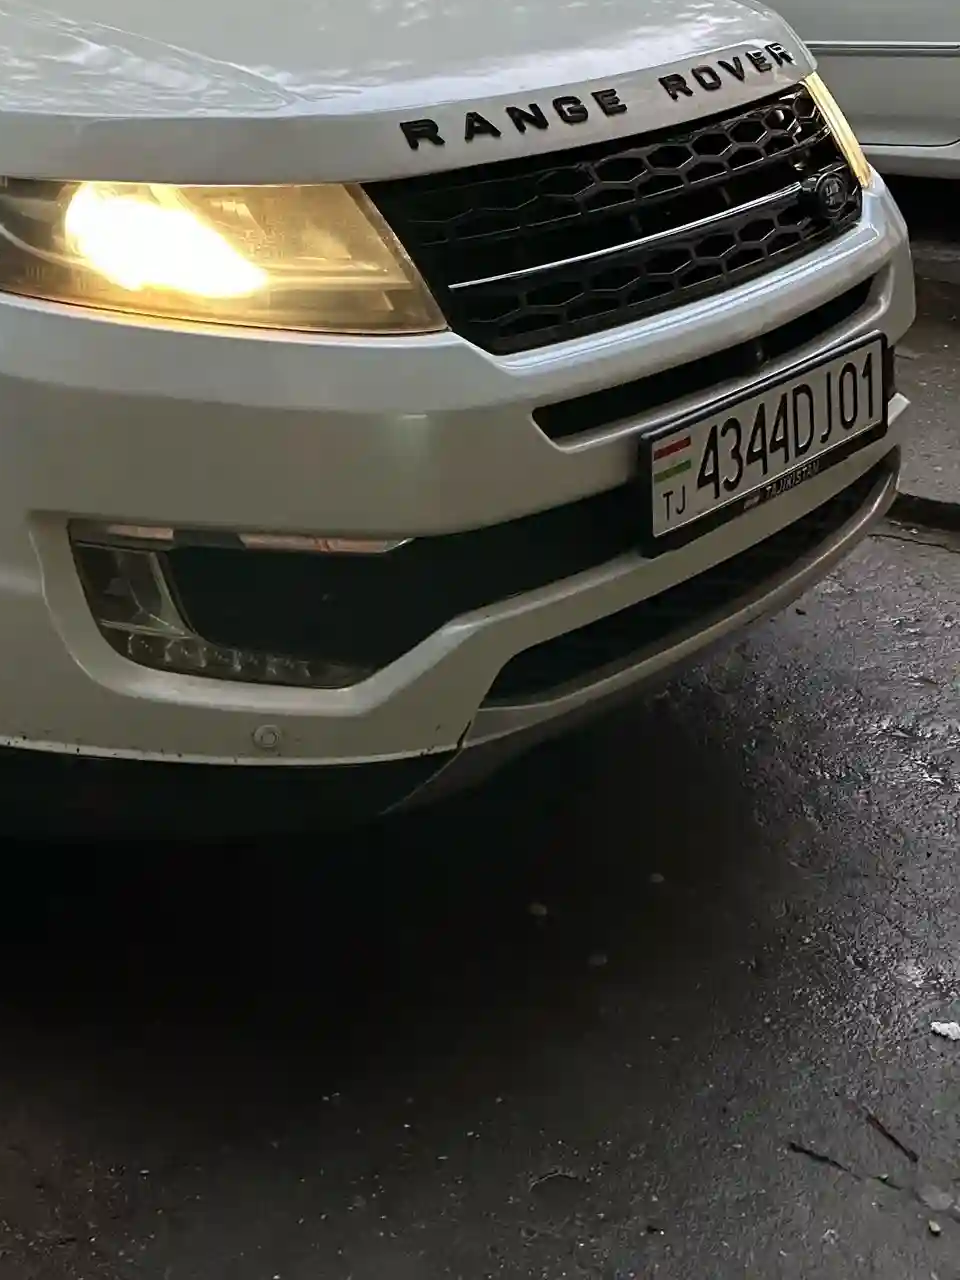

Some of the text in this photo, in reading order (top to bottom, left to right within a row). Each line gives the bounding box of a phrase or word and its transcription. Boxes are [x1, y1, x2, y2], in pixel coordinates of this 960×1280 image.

[400, 42, 795, 150] RANGE ROVER
[662, 485, 686, 521] TJ
